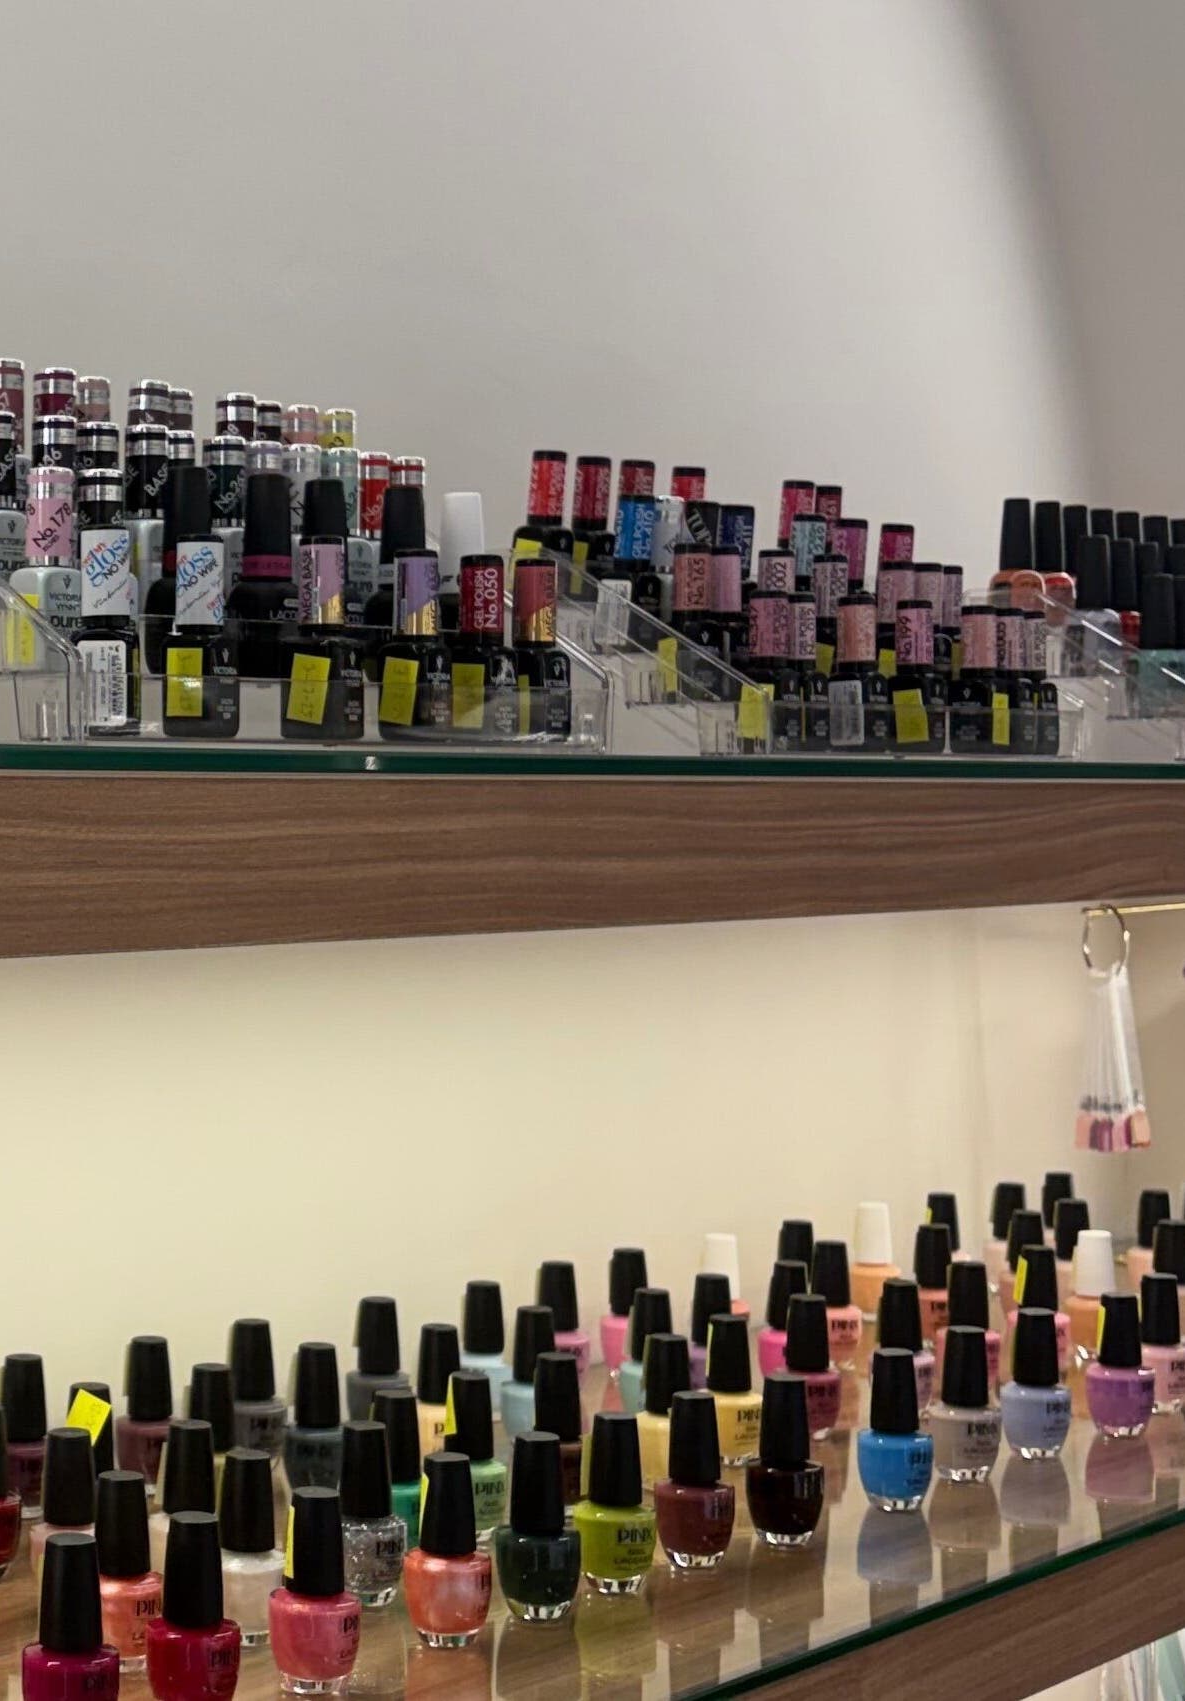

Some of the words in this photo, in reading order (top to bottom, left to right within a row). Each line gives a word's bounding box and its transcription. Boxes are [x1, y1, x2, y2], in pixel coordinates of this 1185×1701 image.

[32, 502, 72, 549] No.178
[301, 547, 312, 579] BASE
[183, 576, 198, 591] NO
[301, 581, 312, 621] MEGA
[474, 570, 484, 605] POLISH
[484, 567, 499, 629] No.050
[474, 609, 484, 630] GEL
